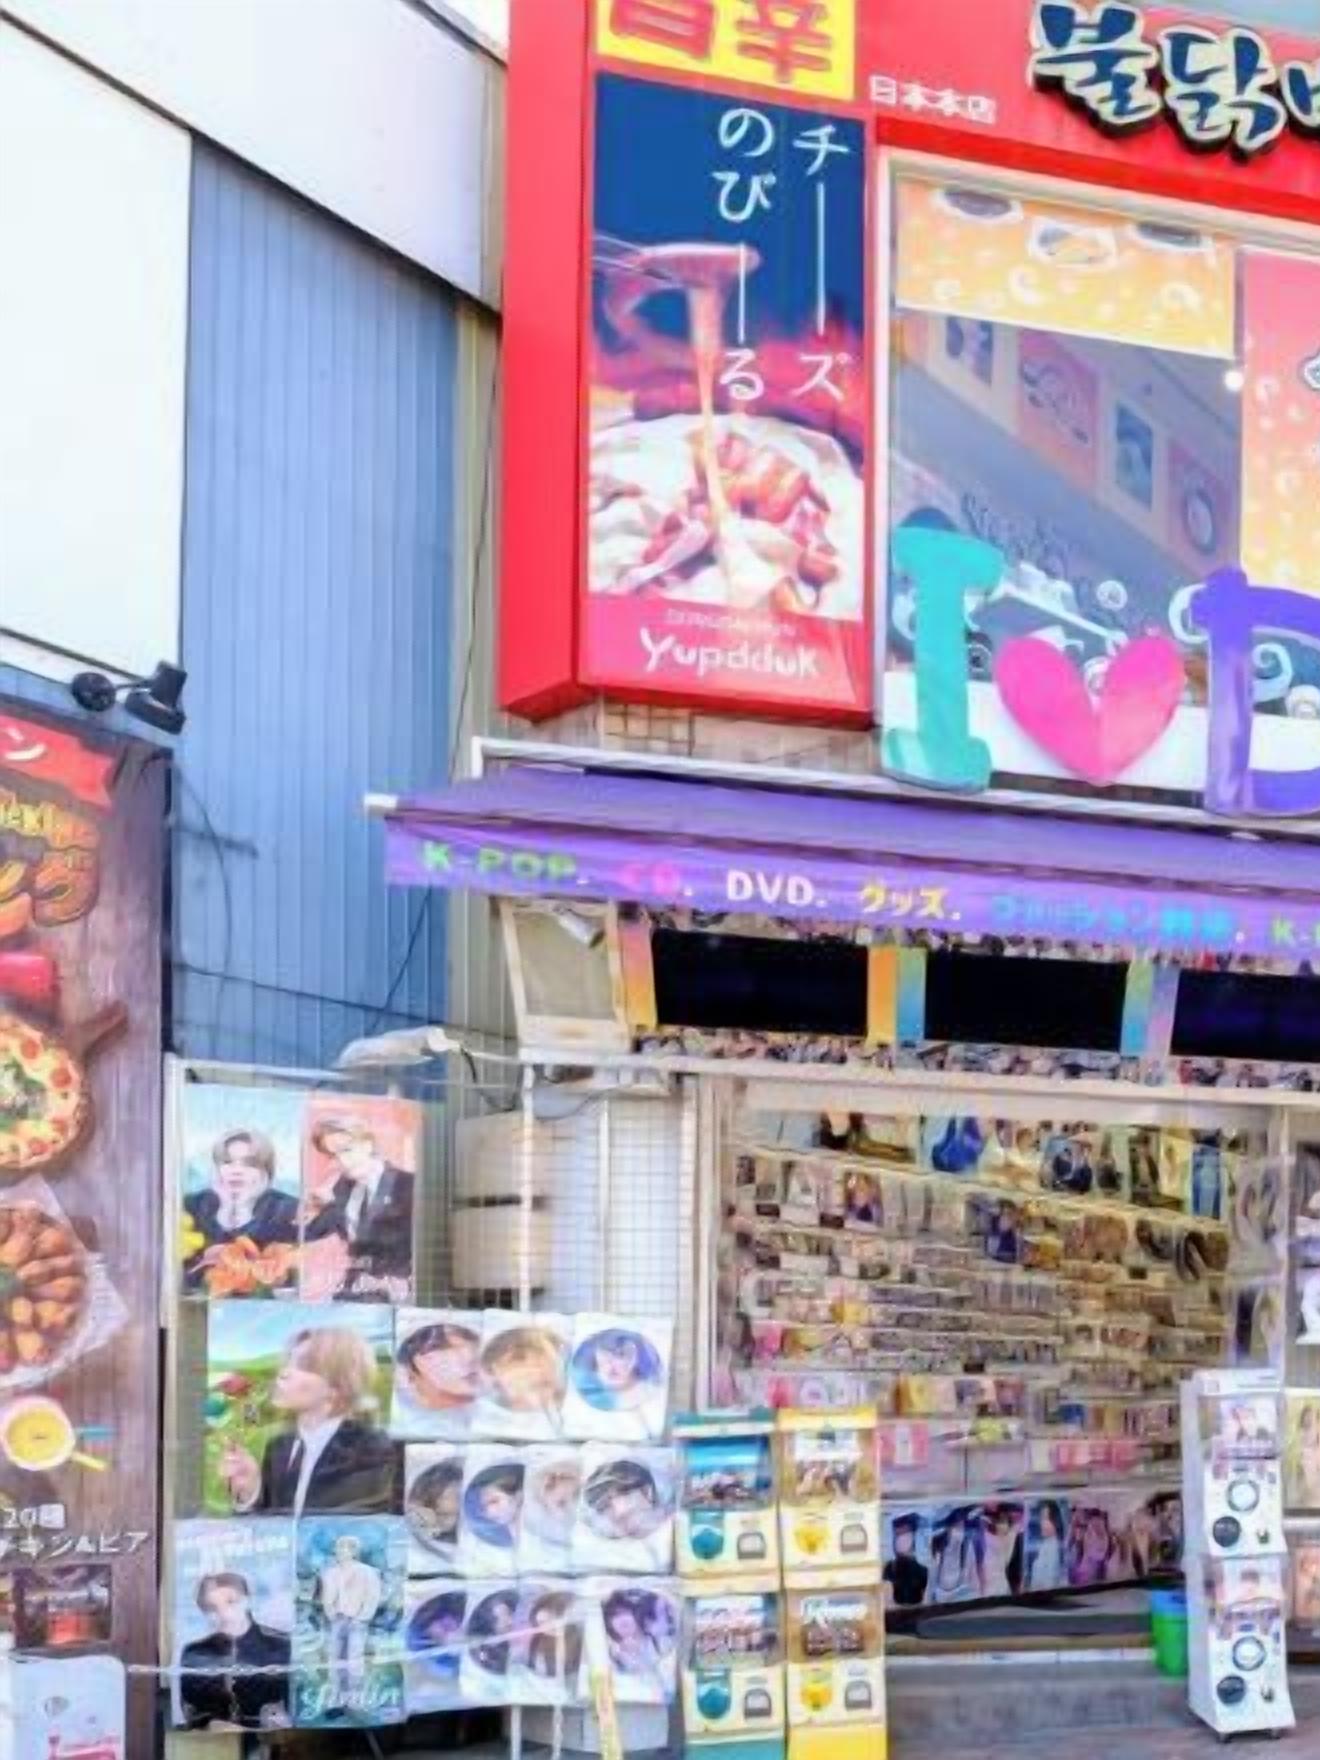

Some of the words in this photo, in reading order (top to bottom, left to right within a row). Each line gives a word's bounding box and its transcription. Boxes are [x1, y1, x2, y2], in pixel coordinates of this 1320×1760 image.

[712, 107, 776, 401] のびーる
[790, 124, 852, 400] チーズ
[727, 869, 828, 908] DVD.
